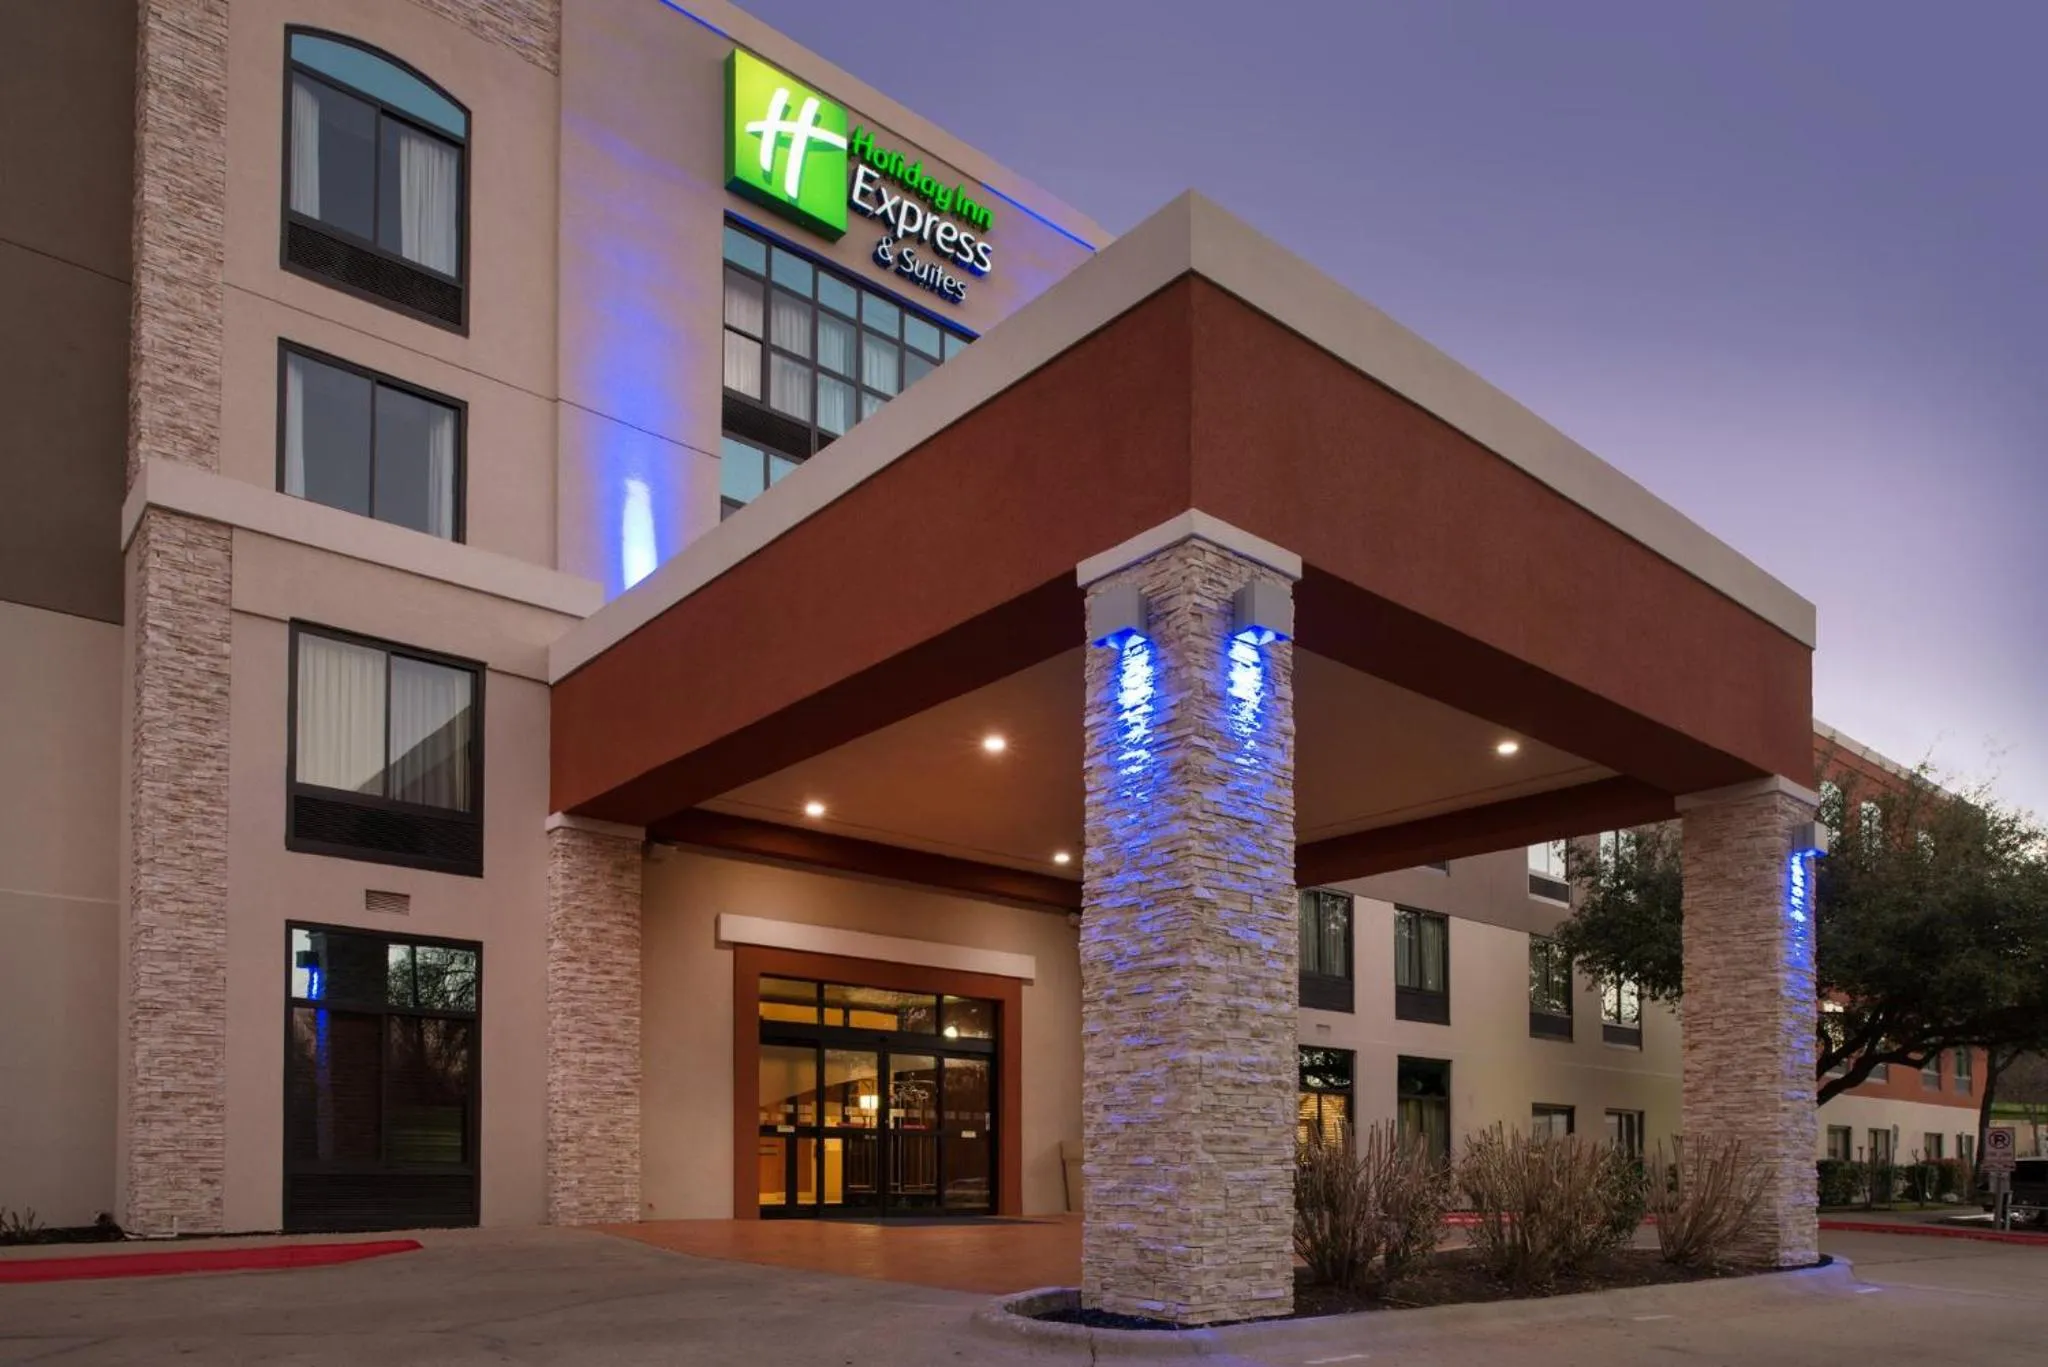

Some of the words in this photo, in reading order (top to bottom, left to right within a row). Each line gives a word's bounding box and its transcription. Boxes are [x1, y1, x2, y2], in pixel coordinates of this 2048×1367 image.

[745, 87, 847, 199] H
[851, 125, 951, 211] Holiday
[956, 185, 993, 230] Inn
[852, 163, 992, 273] Express
[876, 236, 894, 263] &
[901, 248, 967, 301] Suites
